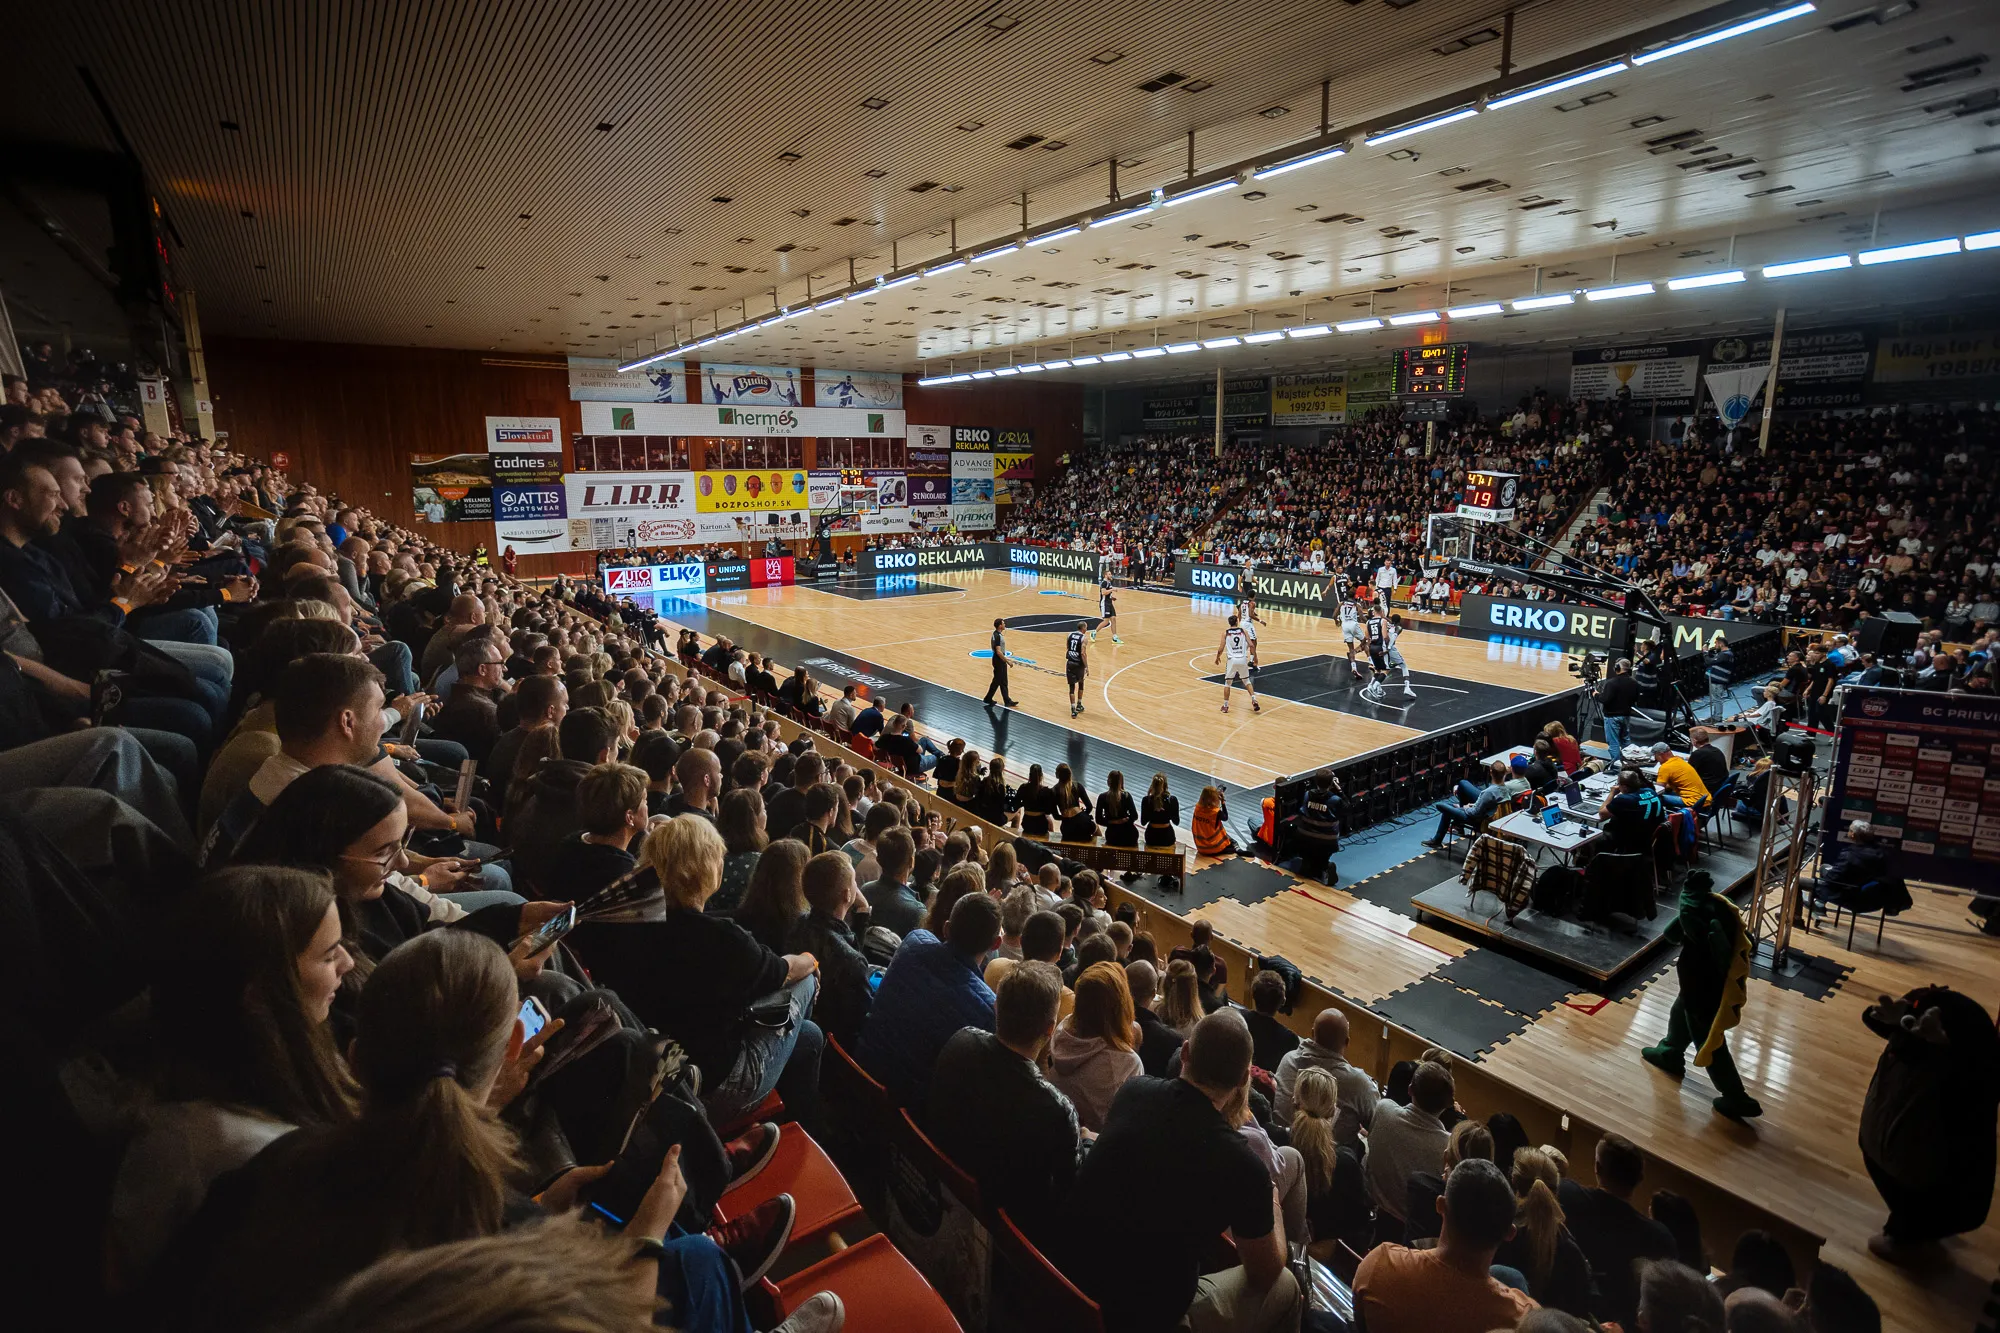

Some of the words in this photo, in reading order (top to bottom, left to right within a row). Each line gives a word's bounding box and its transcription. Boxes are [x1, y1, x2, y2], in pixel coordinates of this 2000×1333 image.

[1414, 367, 1424, 376] 22
[1438, 366, 1444, 374] 19
[1295, 374, 1343, 385] Prievidza
[147, 386, 156, 400] B
[1276, 389, 1310, 400] Majster
[1314, 386, 1342, 397] ČSFR
[200, 402, 206, 412] C
[1290, 401, 1325, 412] 1992/93
[499, 430, 549, 439] Slovaktual
[955, 429, 990, 441] ERKO
[998, 432, 1030, 444] ORVA
[956, 442, 989, 450] REKLAMA
[995, 458, 1033, 470] NAVI
[518, 492, 559, 505] ATTIS
[715, 500, 791, 508] BOZPOSHOP.SK
[1474, 492, 1492, 507] 19
[956, 513, 993, 521] NADKA
[875, 553, 917, 569] ERKO
[918, 548, 985, 566] REKLAMA
[1010, 548, 1038, 565] ERKO
[1040, 553, 1093, 571] REKLAMA
[719, 566, 746, 574] UNIPAS
[627, 580, 651, 588] PRIMA
[1192, 568, 1235, 589] ERKO
[1344, 607, 1352, 615] 17
[1490, 603, 1566, 632] ERKO
[1234, 636, 1240, 646] 9
[1922, 707, 1942, 716] BC
[1307, 801, 1328, 812] PHOTO
[1639, 797, 1661, 819] 77
